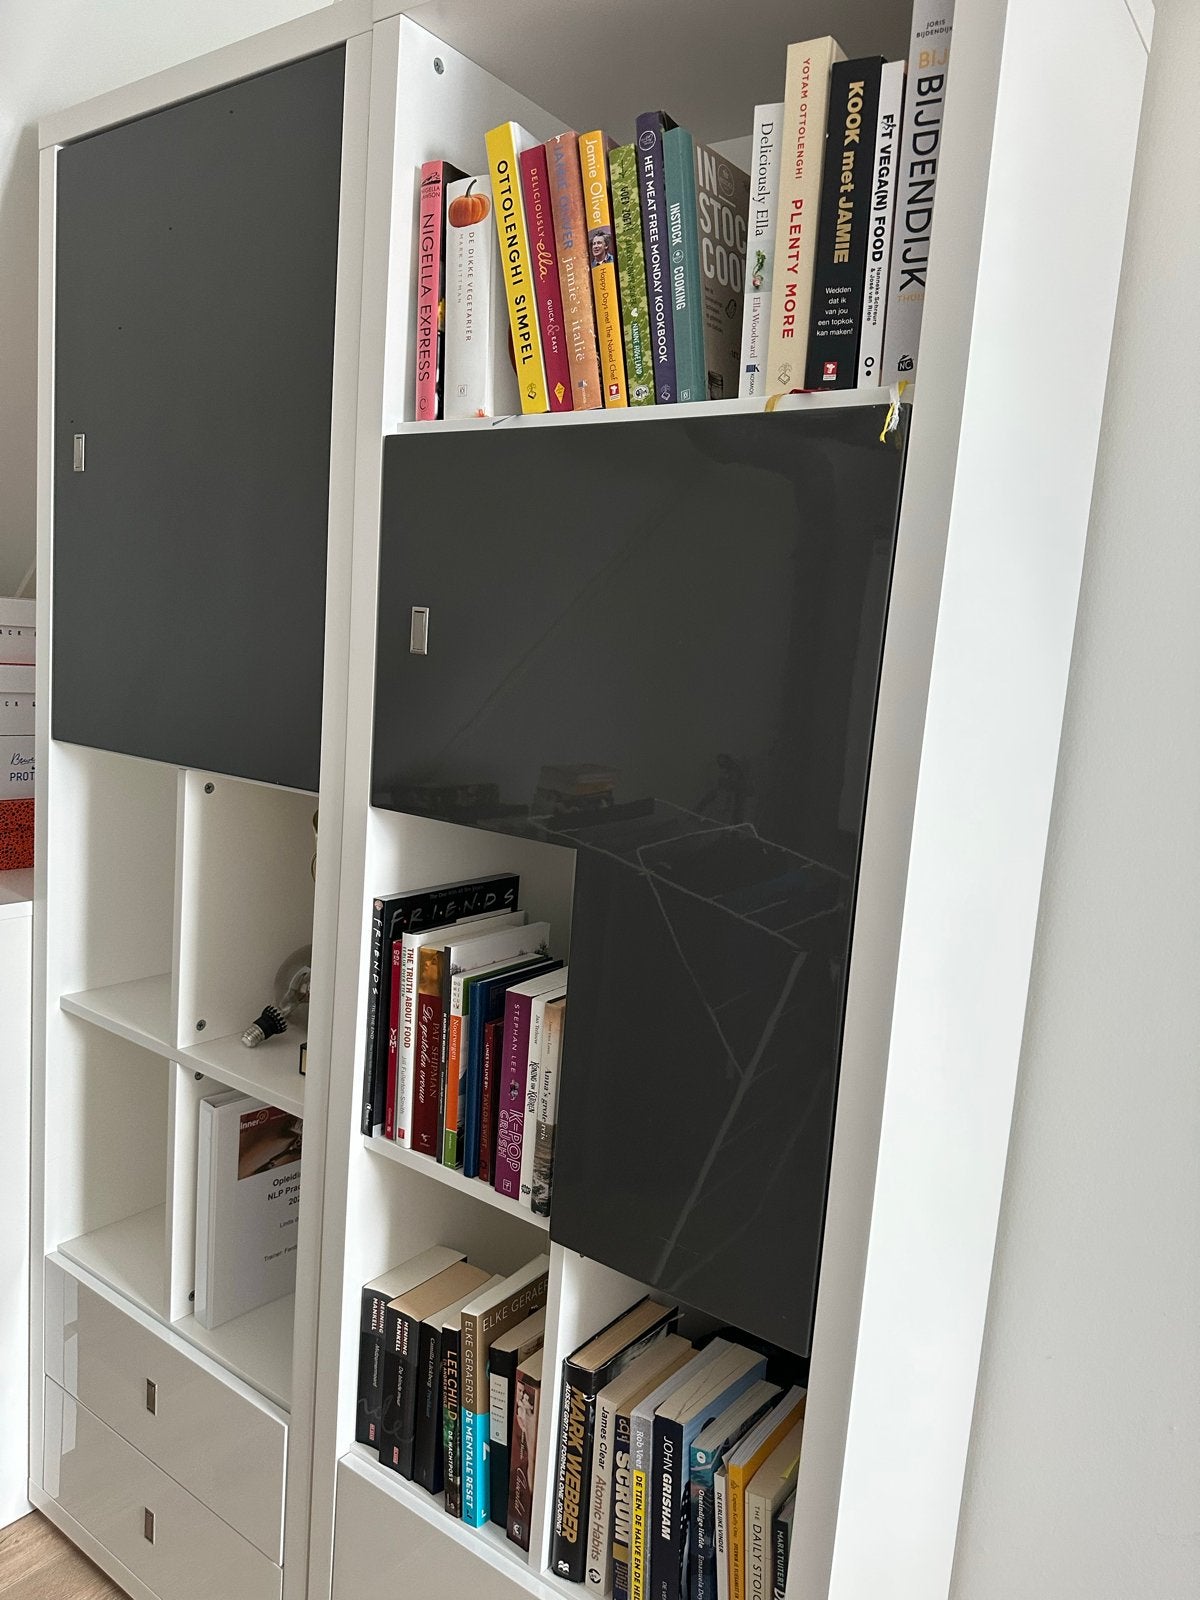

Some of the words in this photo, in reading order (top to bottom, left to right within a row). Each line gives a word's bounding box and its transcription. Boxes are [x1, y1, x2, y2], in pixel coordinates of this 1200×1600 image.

[926, 19, 946, 29] JORIS
[800, 58, 811, 99] YOTAM
[844, 80, 865, 145] KOOK
[586, 140, 600, 178] Jamie
[795, 103, 808, 180] OTTOLENGHI
[644, 155, 654, 178] HET
[696, 146, 718, 197] IN
[752, 122, 774, 204] Deliciously
[840, 150, 855, 193] met
[874, 144, 892, 211] VEGA(N)
[646, 180, 657, 213] MEAT
[900, 74, 944, 292] BIJDENDIJK
[530, 168, 545, 238] DELICIOUSLY
[590, 182, 604, 225] Oliver
[468, 232, 475, 245] DE
[648, 214, 659, 243] FREE
[670, 203, 682, 246] INSTOCK
[755, 210, 769, 237] Ella
[786, 200, 803, 275] PLENTY
[834, 197, 854, 264] JAMIE
[872, 216, 886, 262] FOOD
[420, 214, 435, 298] NIGELLA
[497, 160, 524, 286] OTTOLENGHI
[514, 294, 534, 365] SIMPEL
[650, 244, 663, 293] MONDAY
[562, 256, 581, 314] jamie's
[673, 266, 686, 311] COOKING
[546, 300, 555, 323] QUICK
[752, 296, 761, 313] Ella
[782, 284, 798, 339] MORE
[832, 318, 854, 326] topkok
[838, 308, 849, 316] jou
[418, 304, 432, 382] EXPRESS
[654, 295, 668, 364] KOOKBOOK
[750, 313, 760, 359] Woodward
[830, 328, 853, 336] maken!
[610, 364, 618, 381] Chef
[406, 948, 415, 965] THE
[406, 966, 414, 994] TRUTH
[404, 996, 412, 1025] ABOUT
[422, 1004, 434, 1023] De
[511, 1004, 520, 1051] STEPHAN
[404, 1026, 412, 1049] FOOD
[419, 1022, 431, 1069] gestolen
[432, 1022, 440, 1041] PAT
[451, 1019, 460, 1060] Noorwegen
[430, 1046, 439, 1098] SHIPMAN
[510, 1054, 518, 1073] LEE
[418, 1070, 426, 1104] vrouw
[544, 1067, 552, 1097] Anna's
[541, 1099, 549, 1123] grote
[498, 1110, 511, 1158] CRUSH
[540, 1123, 548, 1140] reis
[268, 1190, 284, 1201] NLP
[465, 1321, 474, 1348] ELKE
[482, 1305, 508, 1332] ELKE
[447, 1350, 458, 1376] LEE
[465, 1350, 474, 1405] GERAERTS
[447, 1378, 458, 1421] CHILD
[564, 1382, 572, 1410] AUSSIE
[465, 1410, 474, 1425] DE
[568, 1386, 586, 1454] MARK
[600, 1406, 610, 1441] James
[448, 1430, 454, 1441] DE
[465, 1426, 474, 1476] MENTALE
[562, 1432, 569, 1445] MY
[636, 1430, 645, 1448] Rob
[560, 1445, 568, 1481] FORMULA
[599, 1442, 608, 1471] Clear
[663, 1436, 674, 1473] JOHN
[465, 1478, 474, 1509] RESET
[562, 1454, 583, 1543] WEBBER
[594, 1474, 607, 1521] Atomic
[615, 1450, 631, 1543] SCRUM
[636, 1476, 643, 1488] DE
[717, 1492, 723, 1502] DE
[556, 1499, 564, 1537] JOURNEY
[635, 1514, 642, 1527] DE
[662, 1474, 673, 1541] GRISHAM
[697, 1489, 705, 1528] Oneindige
[592, 1522, 604, 1561] Habits
[634, 1528, 642, 1556] HALVE
[752, 1523, 762, 1563] DAILY
[777, 1530, 785, 1554] MARK
[634, 1558, 641, 1569] EN
[634, 1572, 641, 1584] DE
[777, 1555, 785, 1588] TUITERT
[662, 1581, 668, 1590] DE
